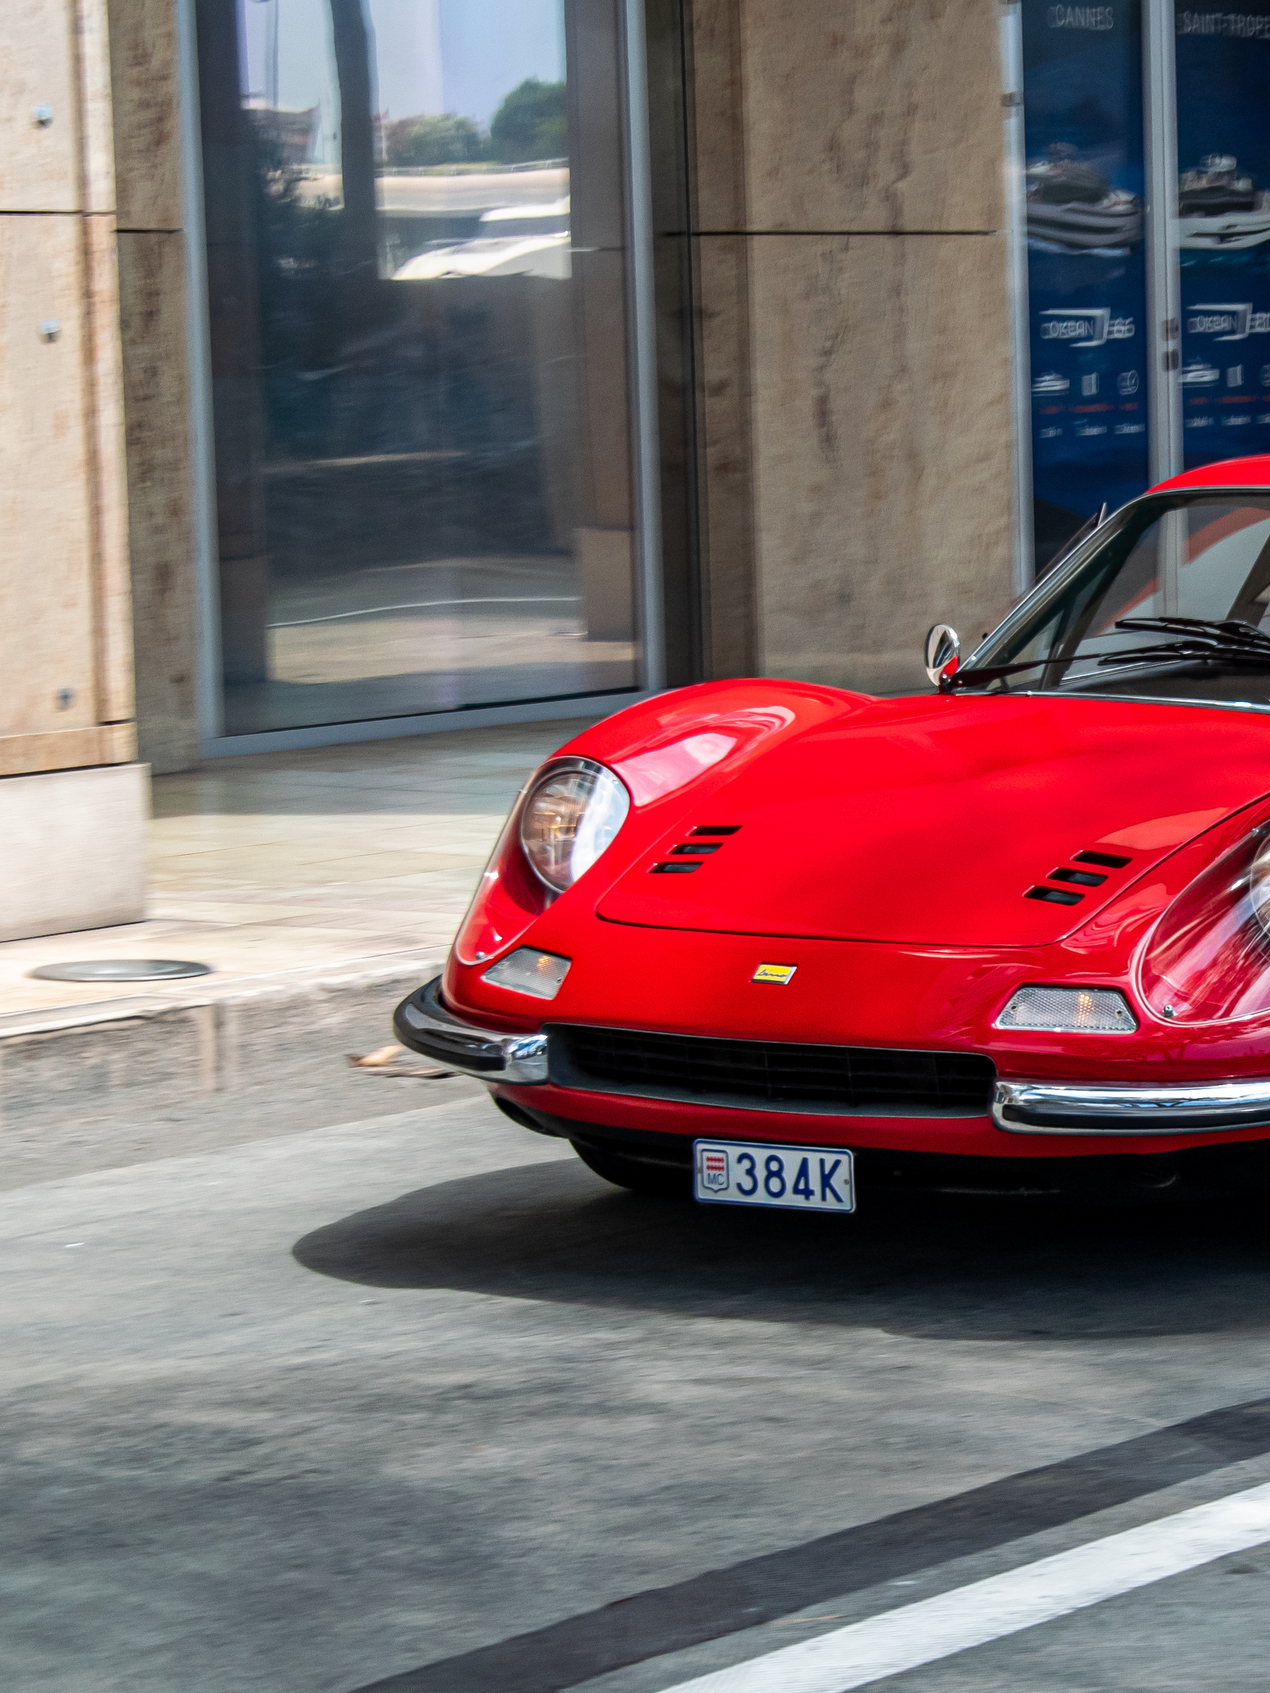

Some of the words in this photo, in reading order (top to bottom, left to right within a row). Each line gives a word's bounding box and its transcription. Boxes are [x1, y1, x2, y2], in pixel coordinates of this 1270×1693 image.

[1050, 4, 1114, 31] CANNES
[1043, 320, 1095, 339] OKEAN
[1189, 315, 1238, 333] OKEAN
[706, 1173, 725, 1186] MC
[736, 1152, 844, 1203] 384K
